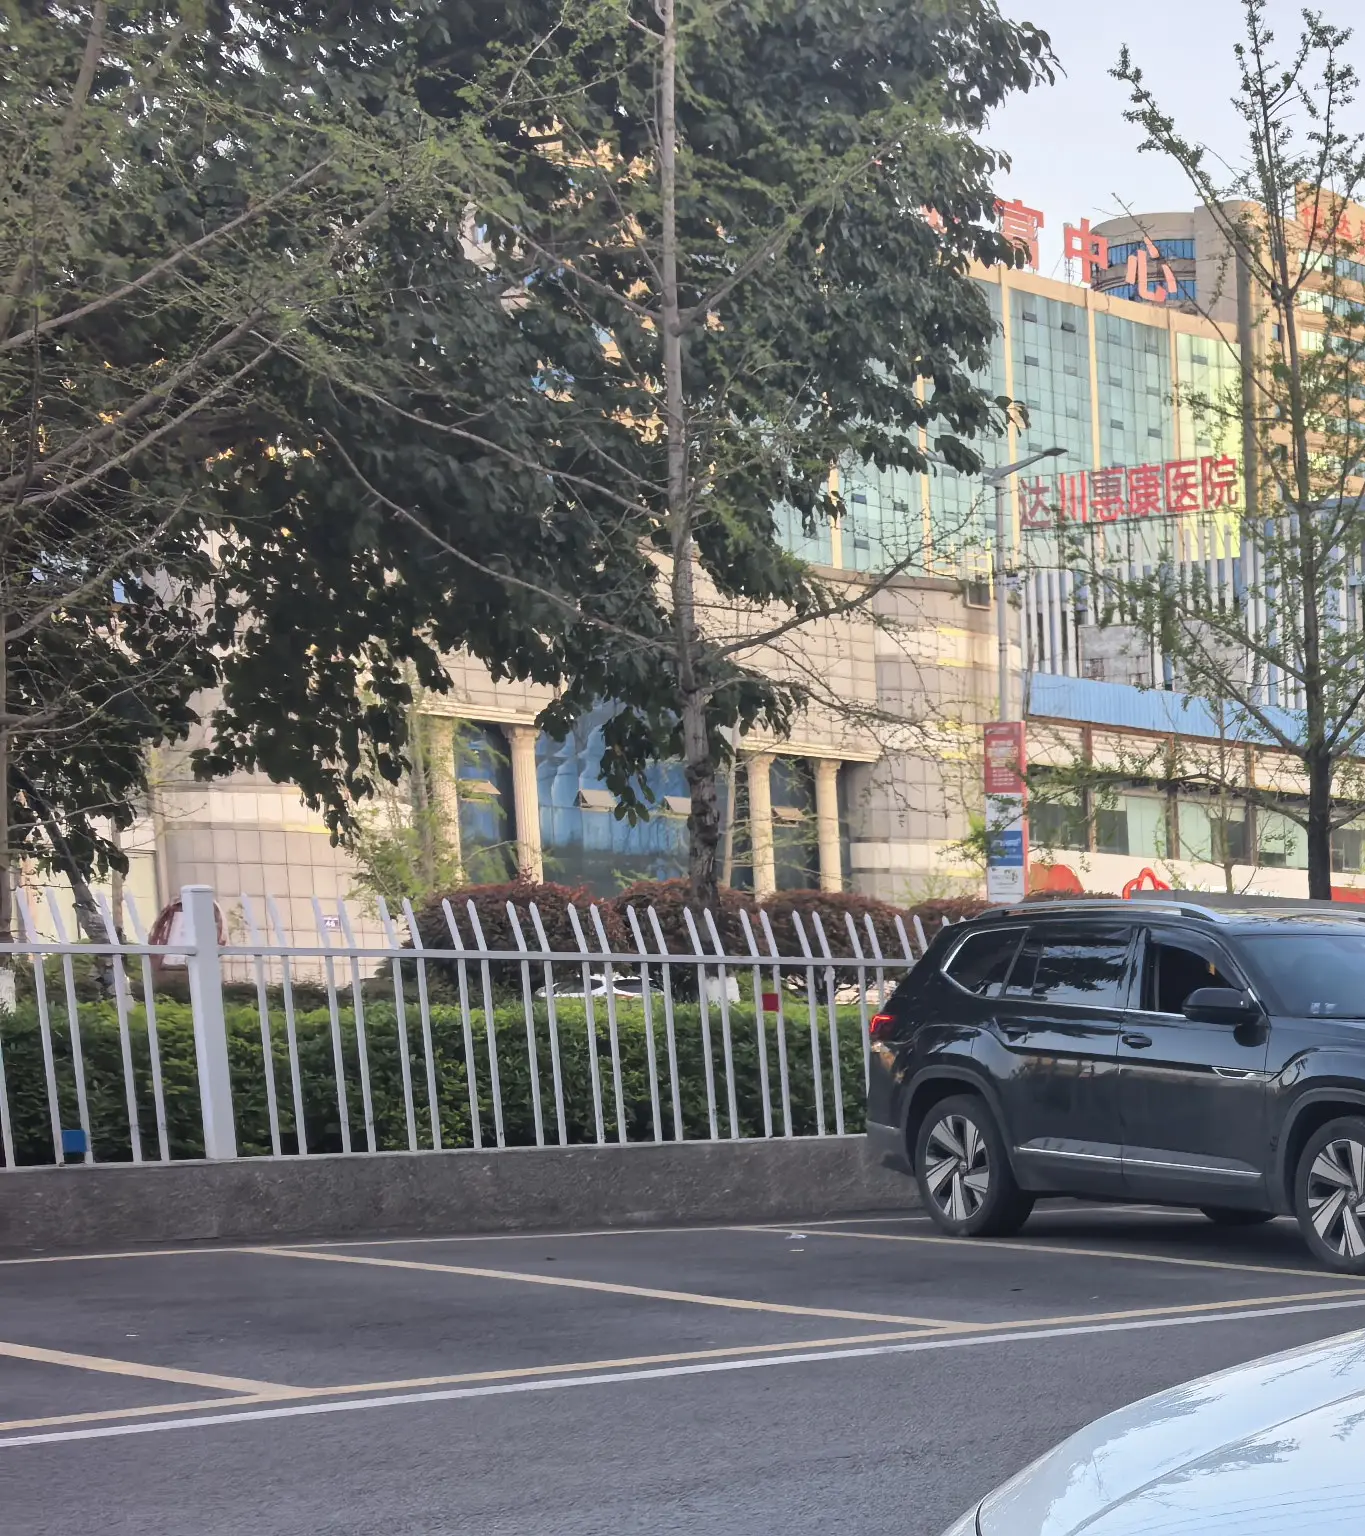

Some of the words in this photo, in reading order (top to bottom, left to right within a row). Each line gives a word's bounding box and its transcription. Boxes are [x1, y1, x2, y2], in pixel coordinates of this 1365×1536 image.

[917, 199, 1178, 302] 富中心
[1020, 454, 1238, 530] 达川惠康医院
